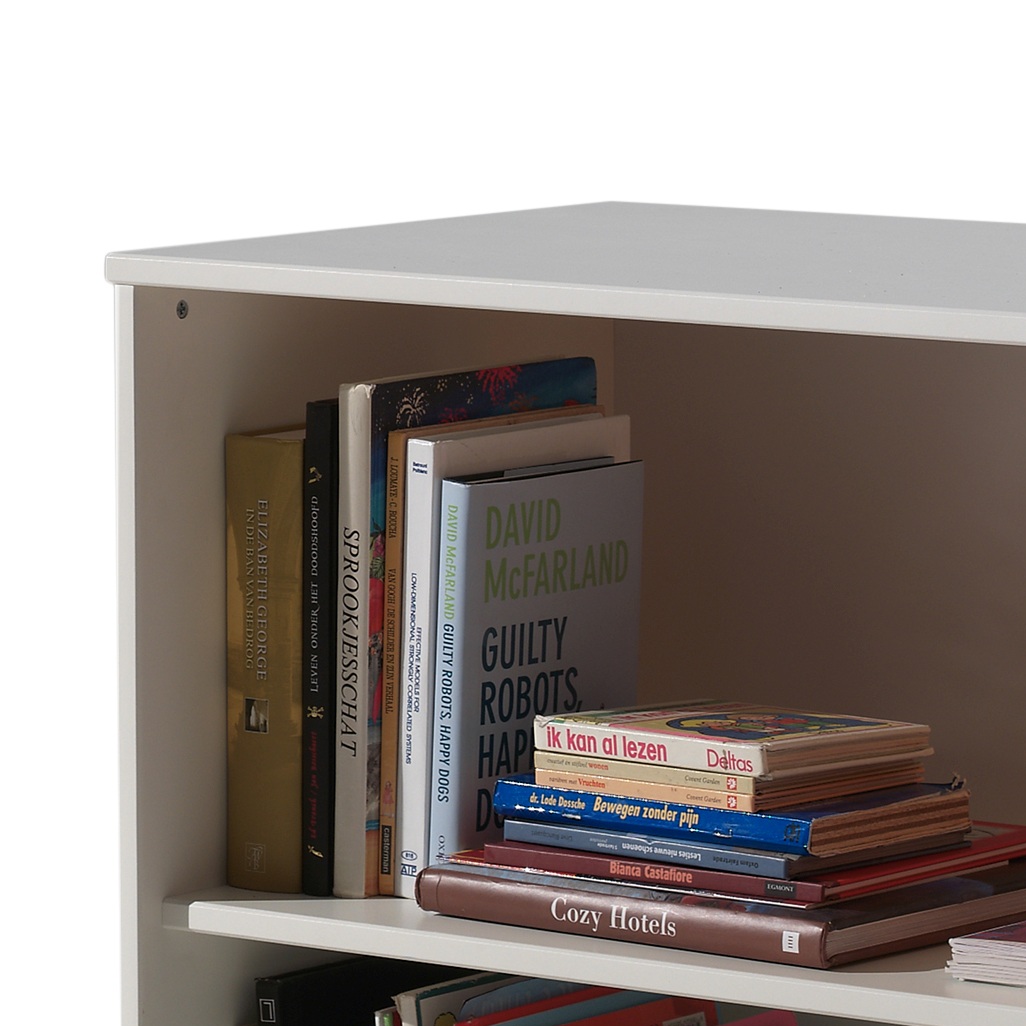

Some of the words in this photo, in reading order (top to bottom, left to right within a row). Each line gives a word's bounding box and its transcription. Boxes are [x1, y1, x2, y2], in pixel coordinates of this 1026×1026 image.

[246, 508, 255, 523] IN
[447, 504, 459, 542] DAVID
[485, 497, 561, 550] DAVID
[246, 526, 255, 545] DE
[257, 500, 269, 601] ELIZABETH
[245, 548, 255, 577] BAN
[387, 569, 397, 584] VAN
[483, 539, 629, 603] McFARLAND
[245, 580, 255, 607] VAN
[310, 581, 319, 605] HET
[386, 584, 396, 605] GOGH
[444, 545, 457, 621] McFARLAND
[310, 604, 321, 650] ONDER
[386, 608, 396, 618] DE
[245, 610, 254, 670] BEDROG
[256, 605, 268, 681] GEORGE
[341, 527, 360, 757] SPROOKJESSCHAT
[385, 619, 396, 653] SCHILDER
[442, 624, 455, 667] GUILTY
[482, 616, 568, 673] GUILTY
[310, 654, 319, 693] LEVEN
[407, 644, 415, 683] STRONGLY
[413, 664, 421, 696] MODELS
[385, 682, 394, 715] VERHAAL
[405, 684, 414, 732] CORRELATED
[439, 669, 453, 721] ROBOTS,
[480, 666, 583, 726] ROBOTS,
[405, 733, 413, 765] SYSTEMS
[439, 725, 451, 766] HAPPY
[478, 727, 534, 779] HAP
[546, 726, 562, 749] ik
[566, 729, 597, 754] kan
[602, 735, 618, 756] al
[623, 735, 667, 762] lezen
[706, 748, 754, 774] Deltas
[437, 769, 450, 803] DOGS
[578, 778, 606, 789] Vruchten
[529, 792, 539, 804] dr.
[541, 794, 558, 807] Lode
[558, 797, 587, 811] Dossche
[593, 796, 641, 820] Bewegen
[642, 805, 677, 822] zonder
[679, 807, 700, 829] pijn
[382, 828, 391, 874] casterman
[621, 842, 653, 855] schoenen
[653, 847, 678, 859] nieuwe
[611, 861, 641, 881] Bianca
[645, 862, 694, 884] Castafiore
[766, 882, 795, 894] EGMONT
[550, 896, 602, 933] Cozy
[610, 903, 677, 938] Hotels
